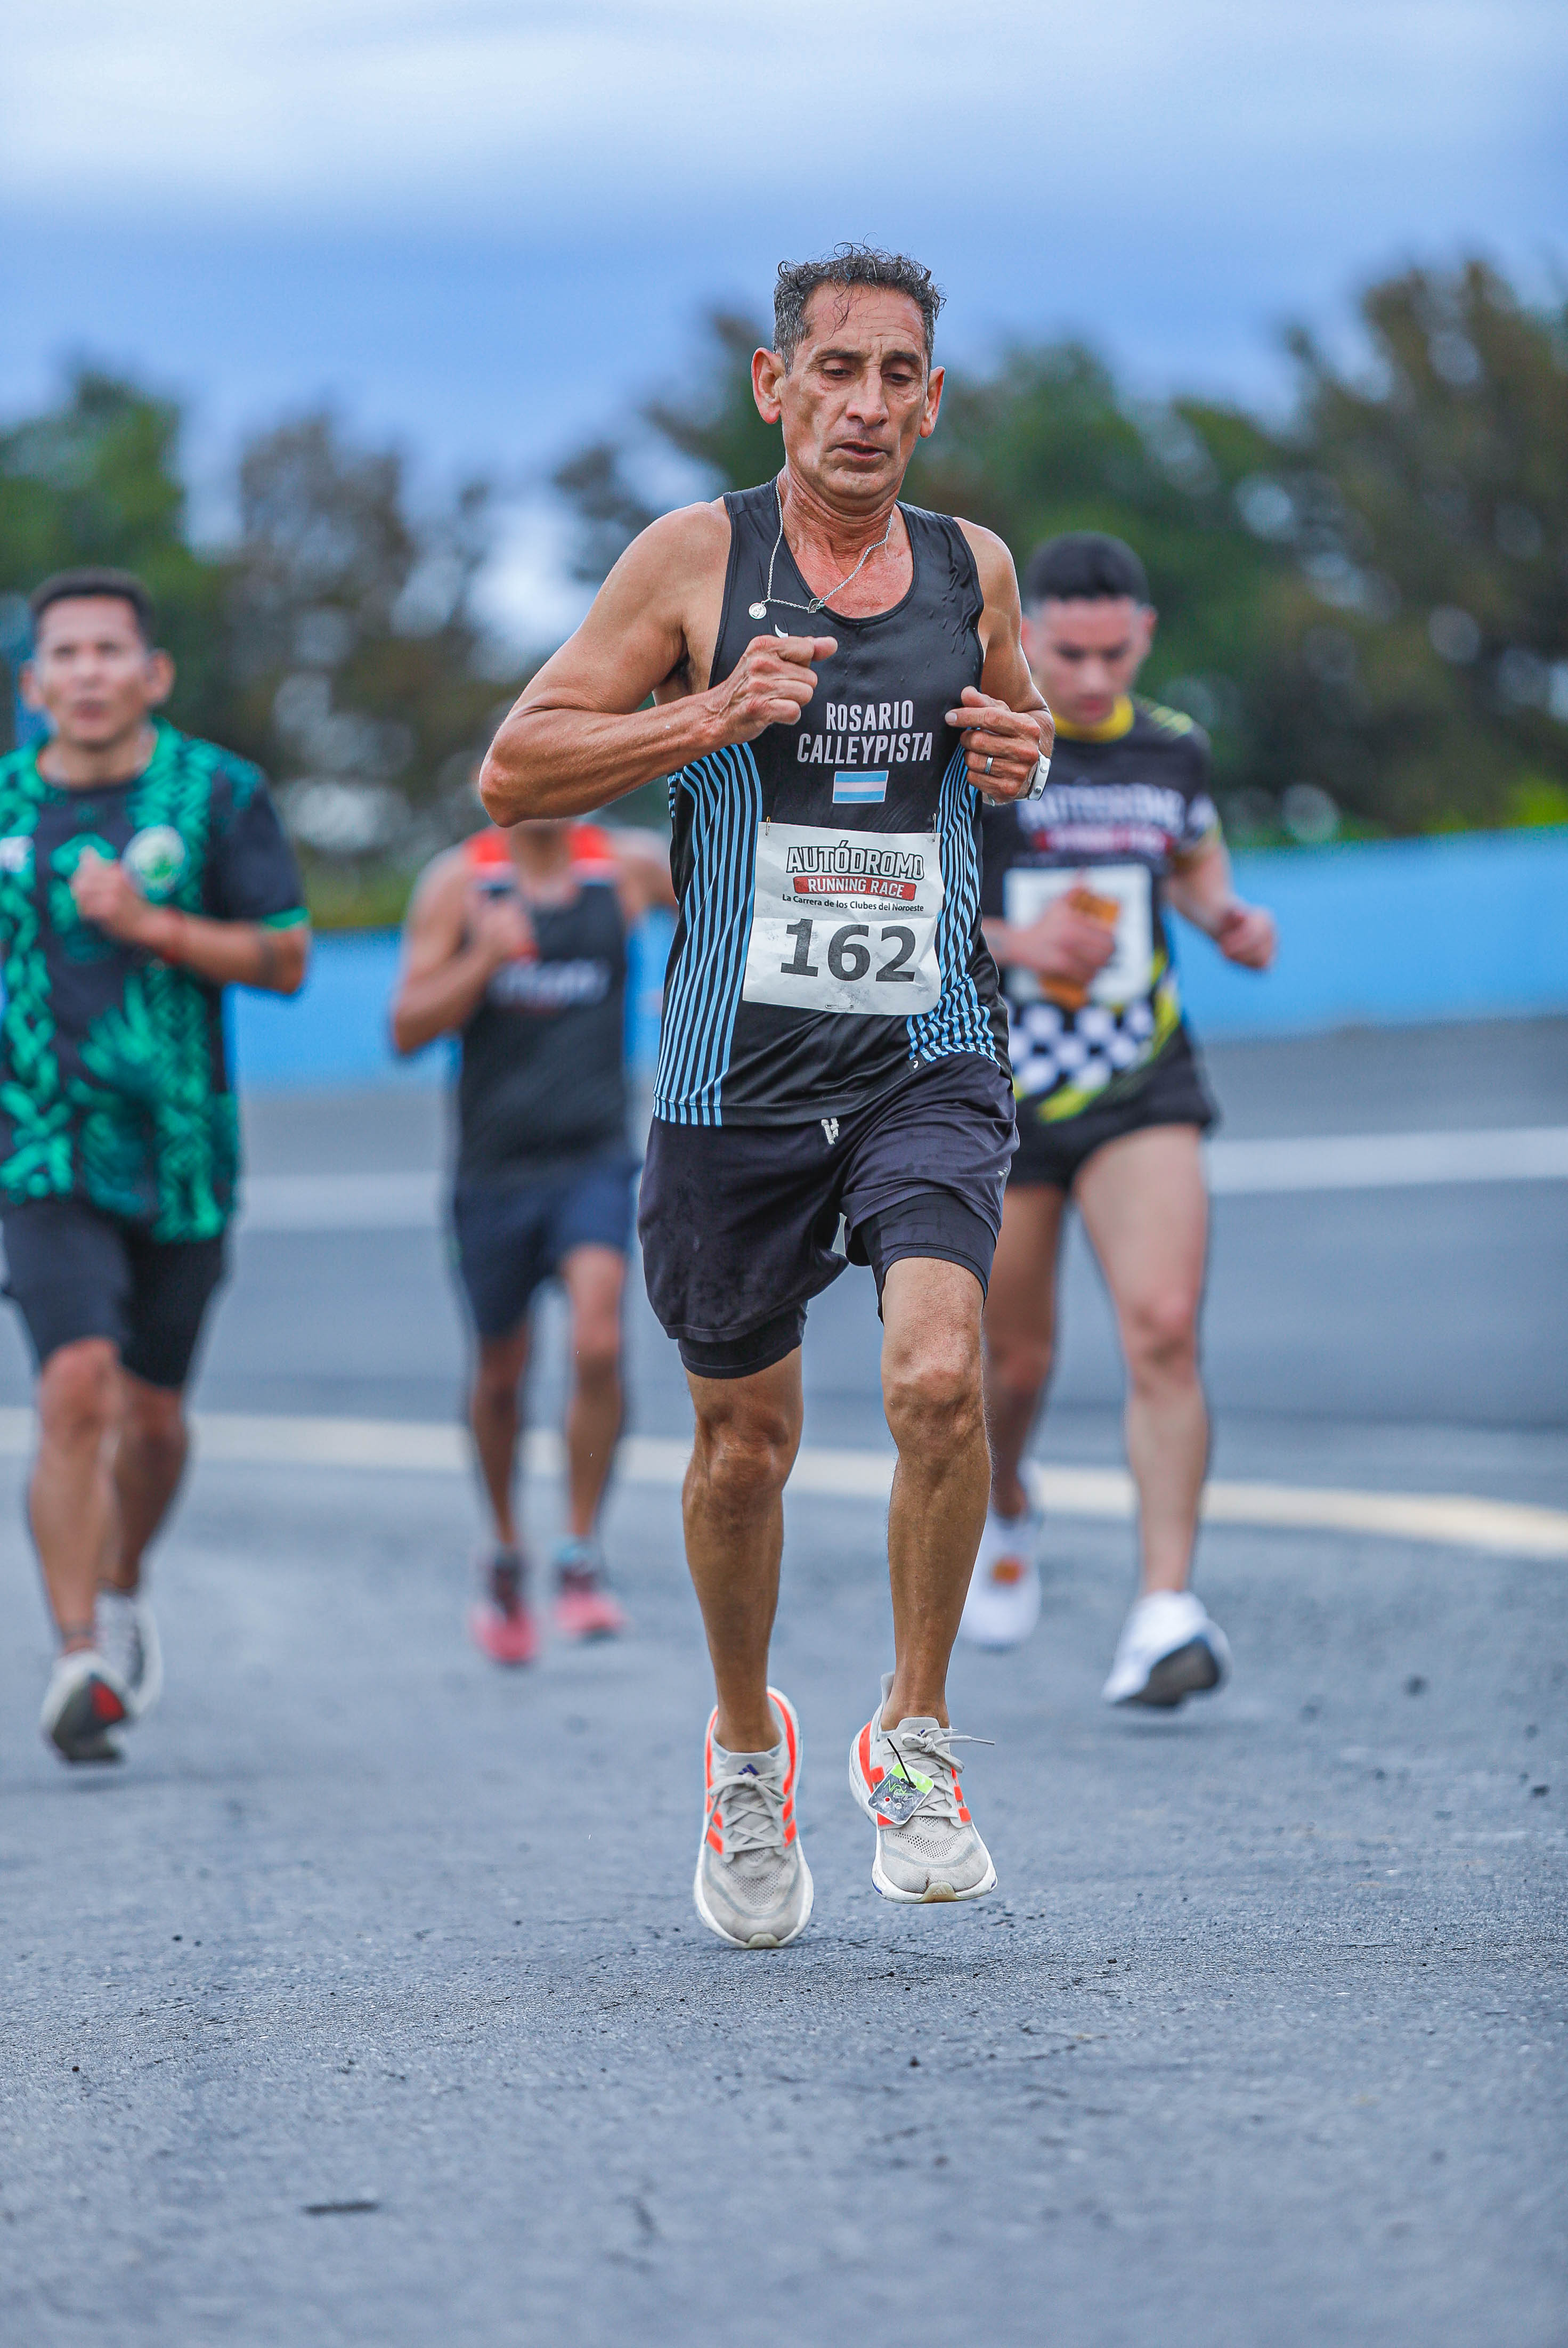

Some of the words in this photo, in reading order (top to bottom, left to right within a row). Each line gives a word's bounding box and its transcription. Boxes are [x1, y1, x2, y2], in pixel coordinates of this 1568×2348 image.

[826, 700, 913, 732] ROSARIO
[797, 732, 932, 764] CALLEYPISTA
[786, 840, 924, 880] AUTÓDROMO
[793, 896, 822, 906] Carrera
[824, 899, 834, 907] de
[836, 900, 848, 908] los
[850, 901, 876, 910] Clubes
[879, 901, 890, 911] del
[892, 903, 924, 912] Noroeste
[808, 878, 866, 893] RUNNING
[870, 881, 905, 898] RACE
[781, 918, 917, 982] 162
